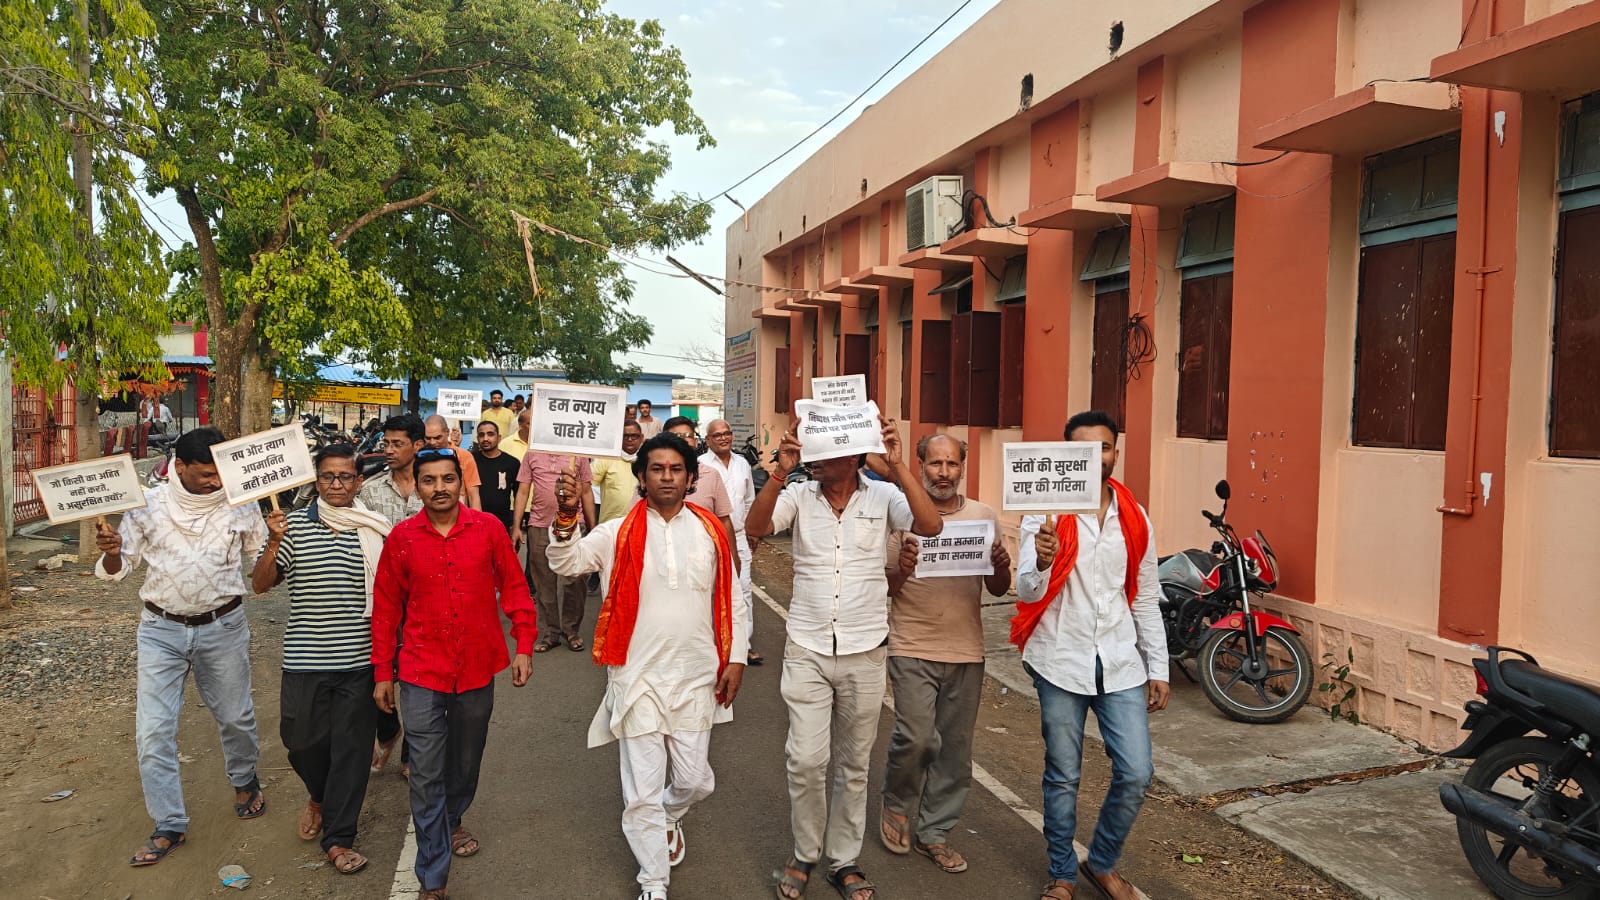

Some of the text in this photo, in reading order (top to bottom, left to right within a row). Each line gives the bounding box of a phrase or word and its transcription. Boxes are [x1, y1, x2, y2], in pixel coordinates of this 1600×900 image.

[548, 398, 607, 415] हम न्याय
[552, 420, 600, 439] चाहते हैं
[833, 433, 850, 445] करो
[230, 437, 286, 462] तप और त्याग
[241, 453, 285, 475] अपमानित
[1012, 457, 1088, 476] संतों की सुरक्षा
[62, 475, 85, 487] किसी
[85, 473, 97, 482] का
[98, 469, 120, 480] अहित
[241, 465, 293, 491] नहीं होने देंगे
[1012, 477, 1087, 495] राष्ट्र की गरिमा
[66, 496, 103, 510] असुरक्षित
[940, 537, 953, 547] का
[953, 536, 985, 547] सम्मान
[922, 551, 984, 563] राष्ट्र का सम्मान
